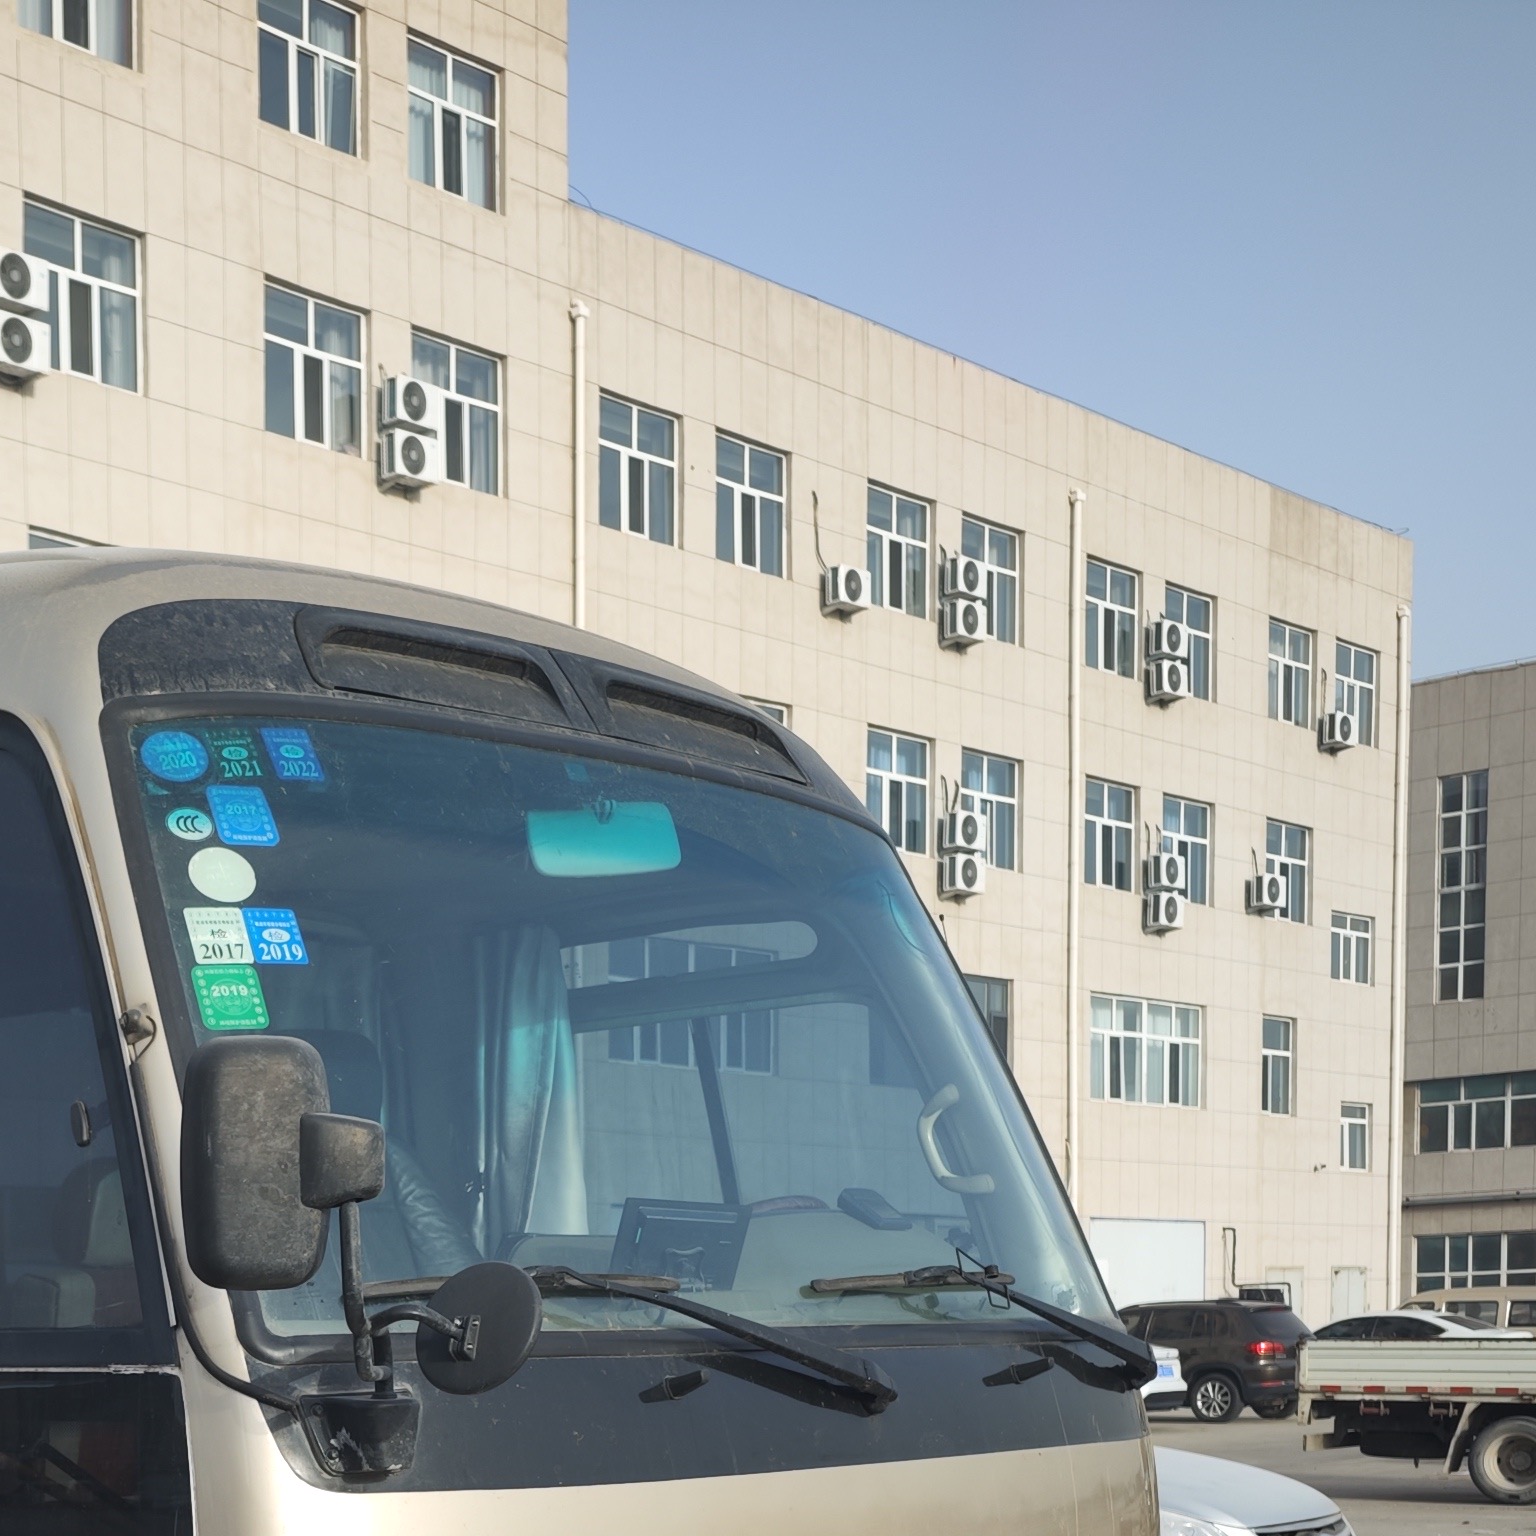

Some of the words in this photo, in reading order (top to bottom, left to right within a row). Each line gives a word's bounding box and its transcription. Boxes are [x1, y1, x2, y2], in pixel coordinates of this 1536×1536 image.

[159, 751, 197, 771] 2020
[220, 761, 263, 778] 2021
[279, 760, 320, 777] 2022
[226, 805, 257, 815] 2017
[199, 943, 244, 960] 2017
[258, 943, 303, 961] 2019
[211, 984, 249, 997] 2019
